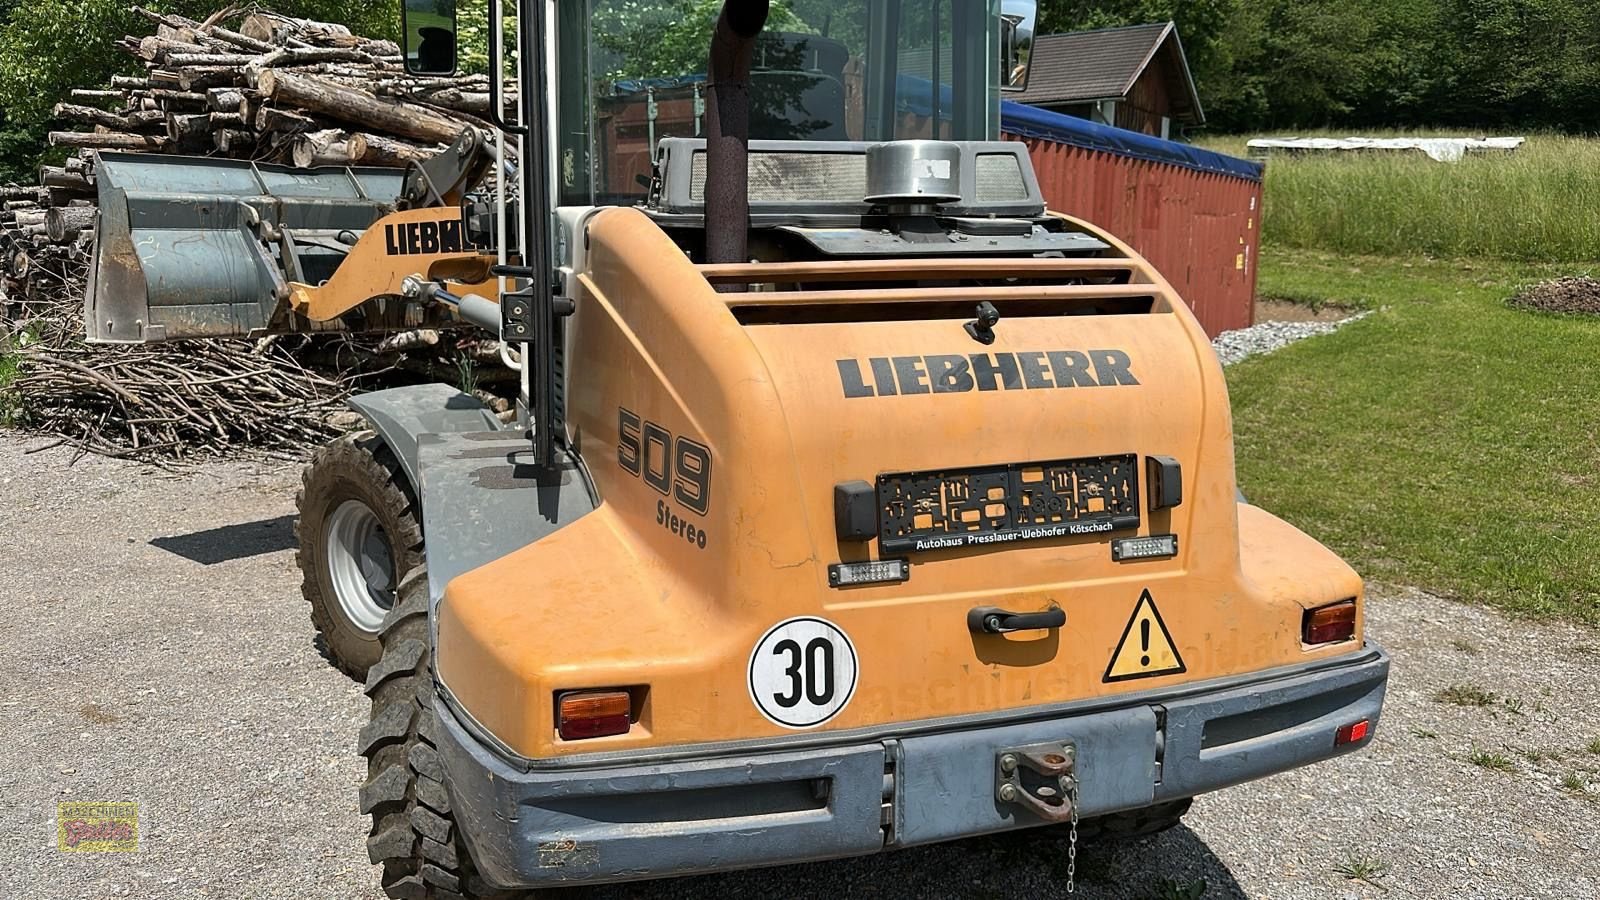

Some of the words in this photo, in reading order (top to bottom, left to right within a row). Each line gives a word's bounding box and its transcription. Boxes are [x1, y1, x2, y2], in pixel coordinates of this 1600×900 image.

[836, 349, 1142, 398] LIEBHERR
[617, 406, 713, 517] 509
[656, 499, 708, 549] Stereo
[916, 536, 963, 550] Autohaus
[967, 527, 1066, 544] Presslauer-Webhofer
[1070, 522, 1113, 534] Kötschach
[773, 637, 834, 708] 30
